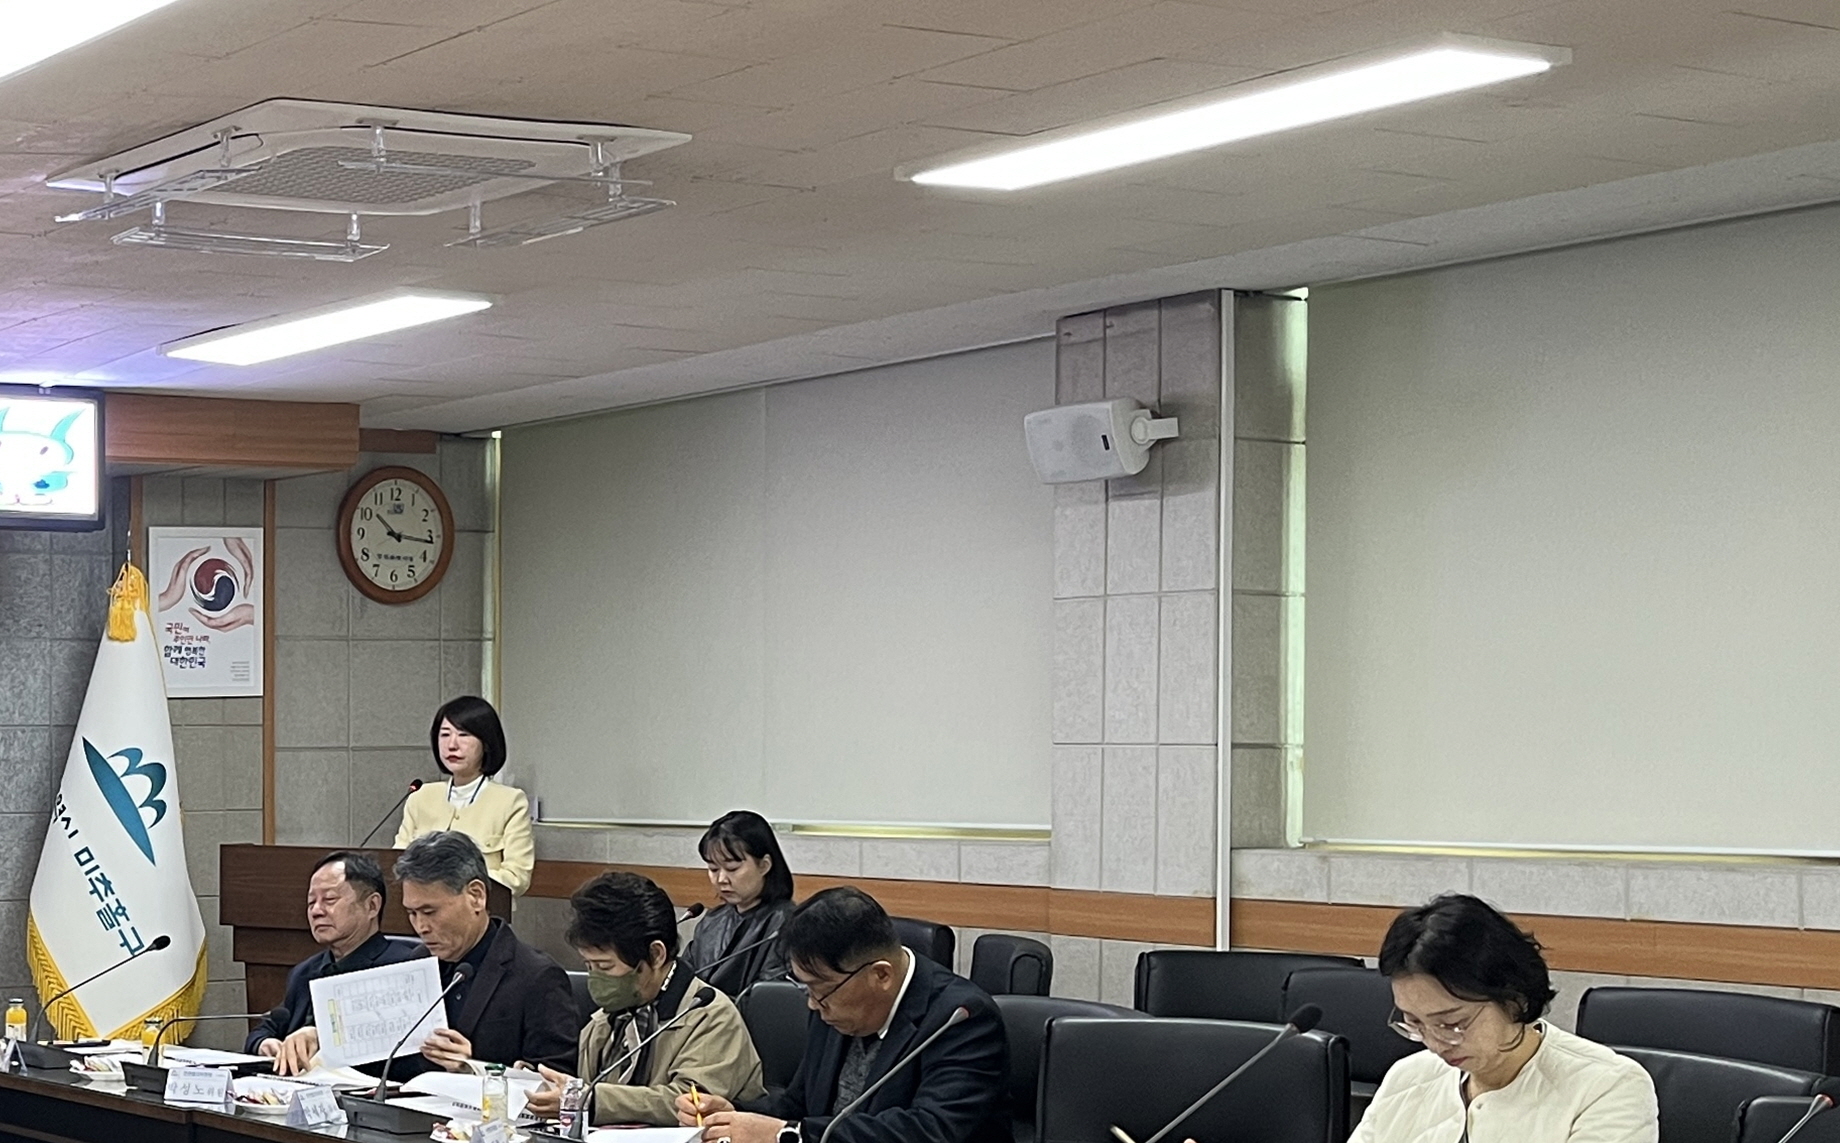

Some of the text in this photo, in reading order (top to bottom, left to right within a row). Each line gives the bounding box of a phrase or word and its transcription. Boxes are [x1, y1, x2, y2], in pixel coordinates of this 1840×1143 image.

[374, 492, 383, 506] 11
[390, 487, 402, 501] 12
[411, 493, 415, 507] 1
[360, 507, 373, 521] 10
[421, 508, 429, 522] 2
[357, 527, 366, 541] 9
[426, 529, 434, 543] 3
[360, 547, 370, 562] 8
[420, 550, 427, 562] 4
[372, 564, 380, 577] 7
[389, 569, 398, 582] 6
[407, 565, 416, 578] 5
[164, 645, 182, 657] 함께
[170, 656, 206, 669] 대한민국
[73, 846, 145, 957] 미추홀구
